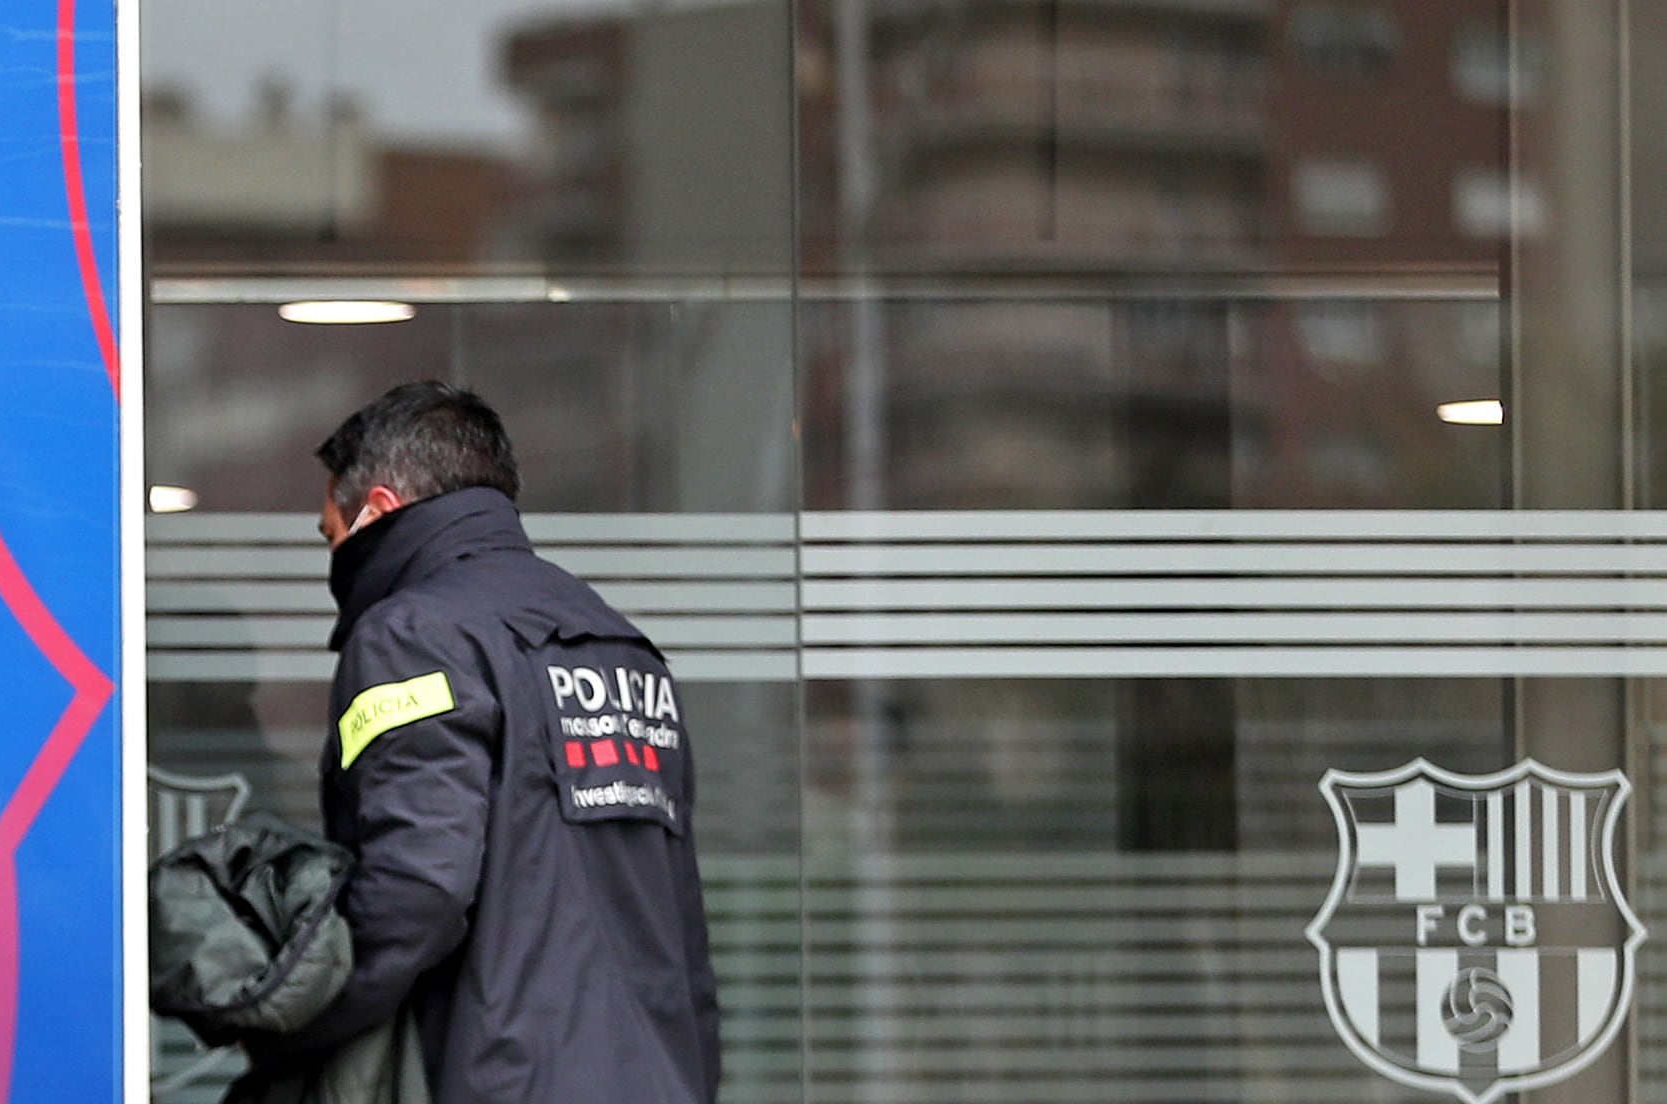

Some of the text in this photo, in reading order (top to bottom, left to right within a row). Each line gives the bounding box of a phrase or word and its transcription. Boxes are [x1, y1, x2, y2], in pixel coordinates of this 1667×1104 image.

[350, 695, 419, 736] POLICIA
[547, 665, 679, 723] POLICIA
[1416, 903, 1537, 947] FCB
